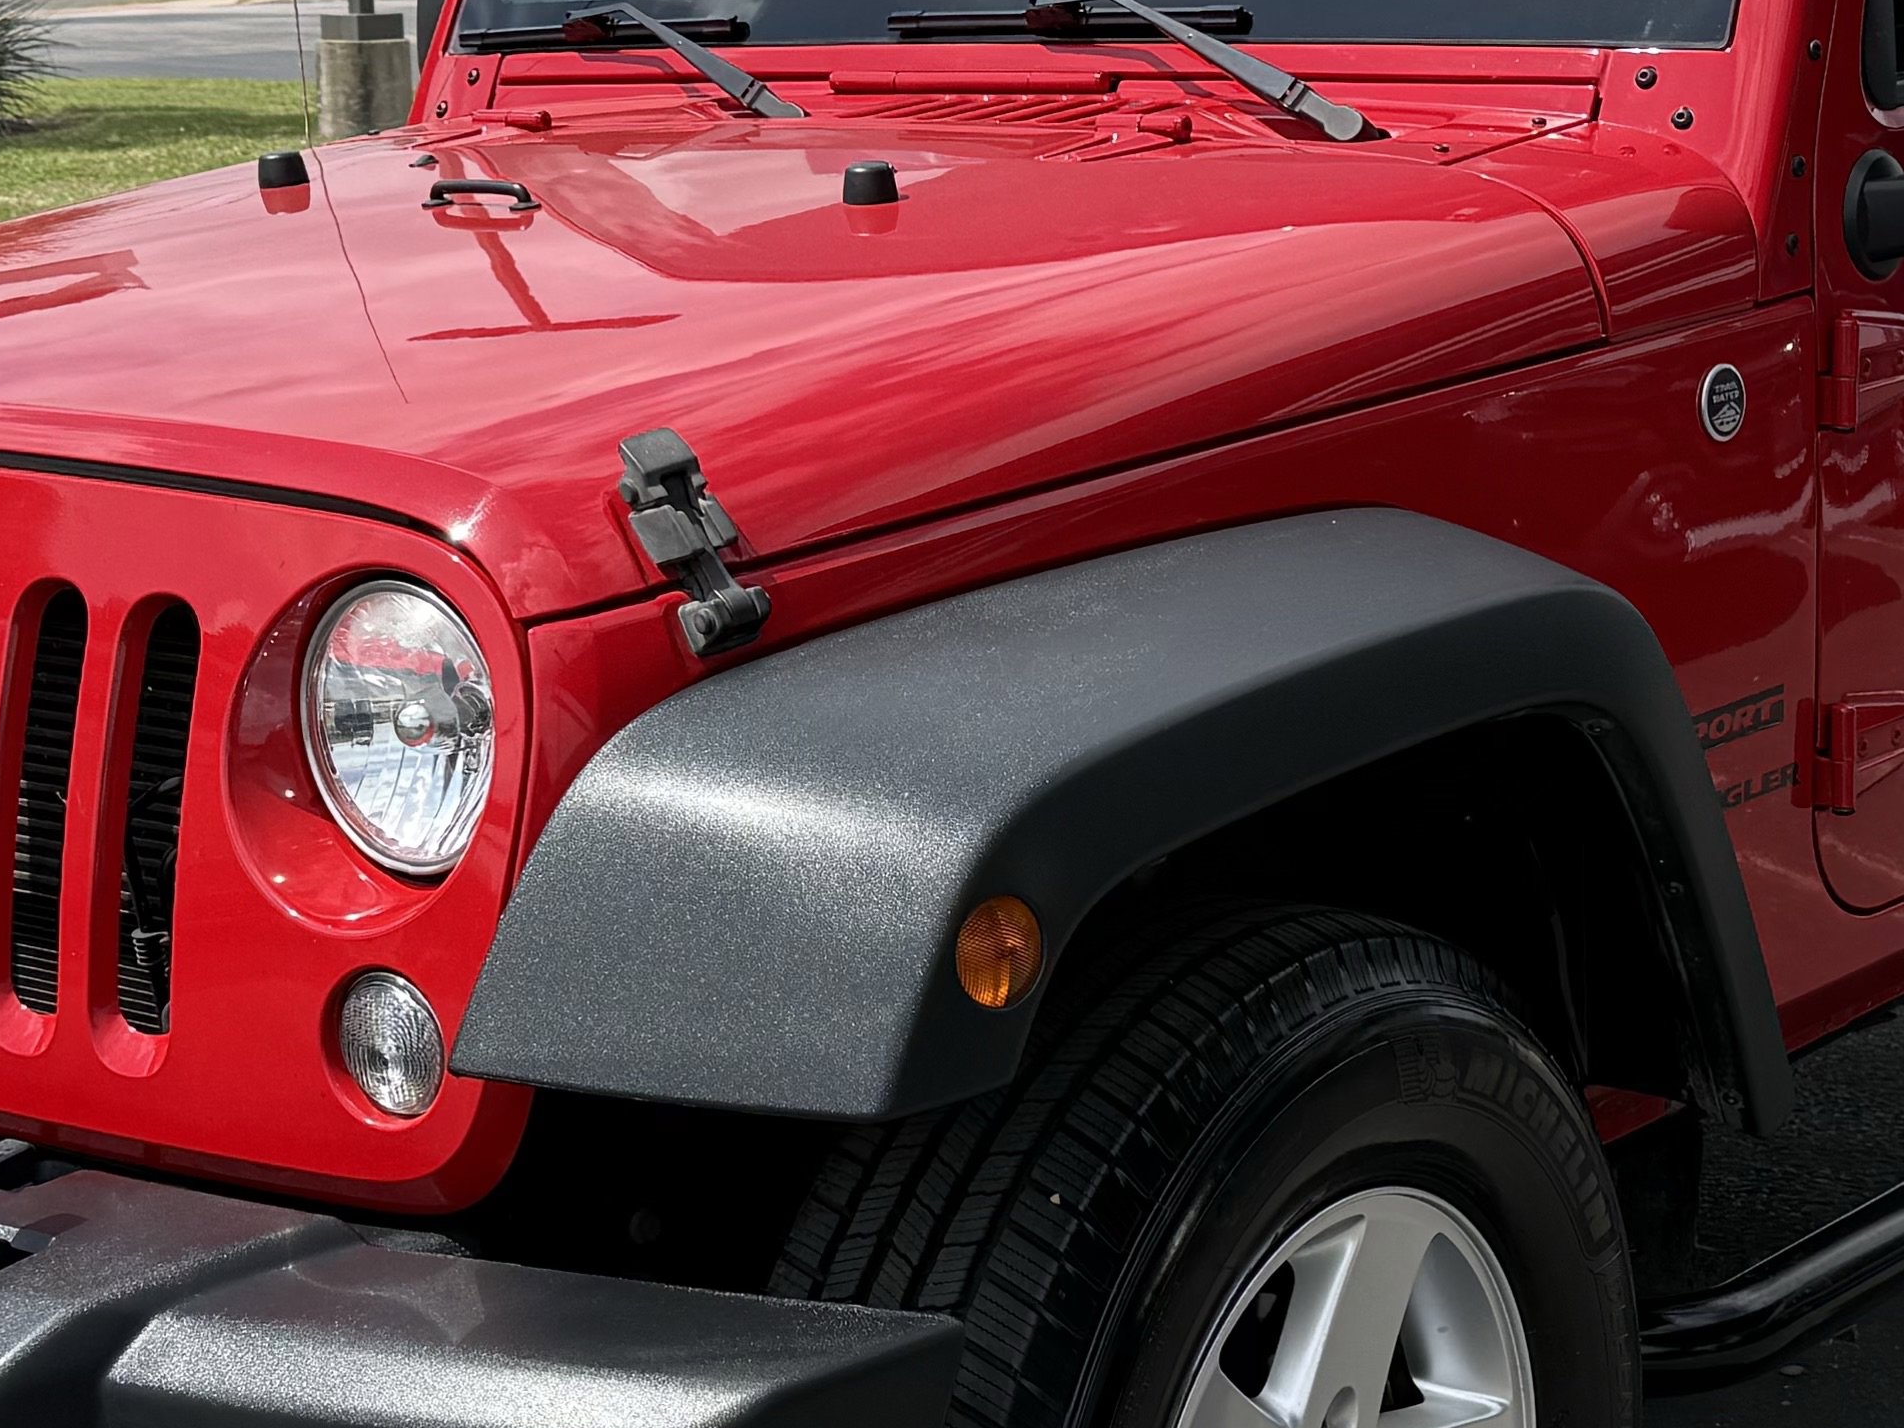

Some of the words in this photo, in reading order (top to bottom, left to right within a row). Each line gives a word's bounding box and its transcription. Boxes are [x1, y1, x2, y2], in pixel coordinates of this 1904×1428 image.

[1696, 694, 1784, 740] PORT
[1720, 761, 1801, 808] GLER
[1462, 1049, 1612, 1244] MICHELIN
